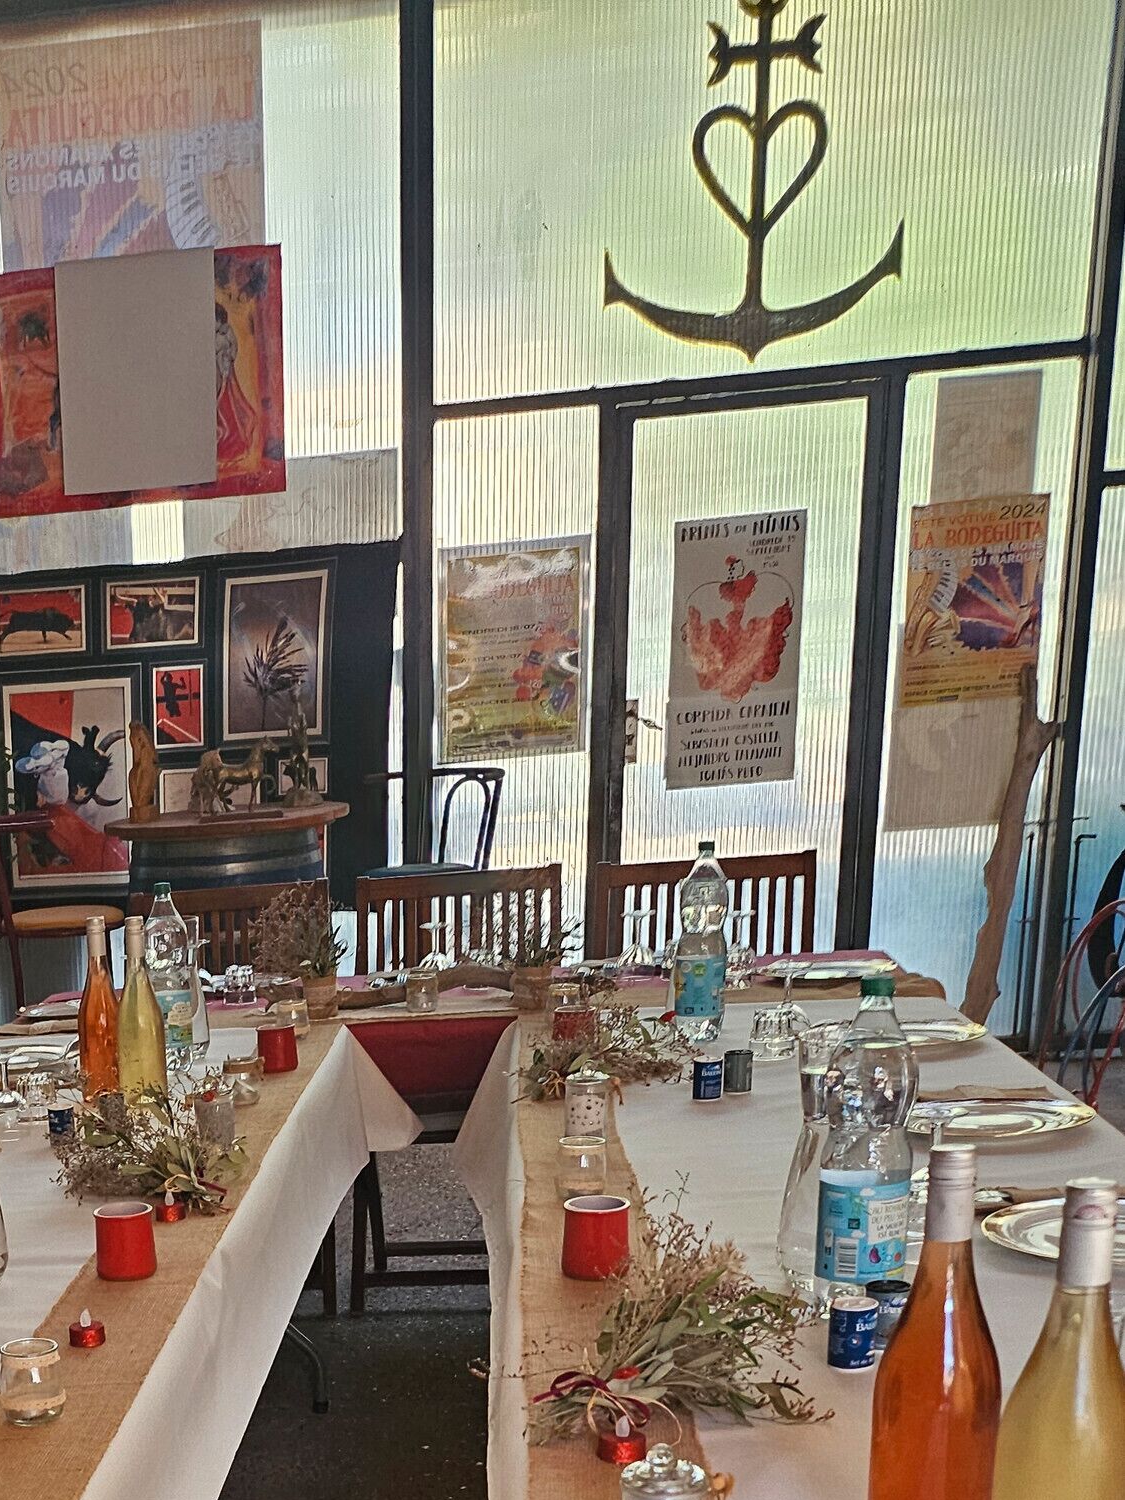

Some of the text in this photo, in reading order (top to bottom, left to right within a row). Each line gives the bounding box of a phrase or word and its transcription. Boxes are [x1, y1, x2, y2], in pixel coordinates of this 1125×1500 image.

[998, 502, 1046, 521] 2024
[913, 531, 934, 550] LA
[970, 557, 987, 568] DU
